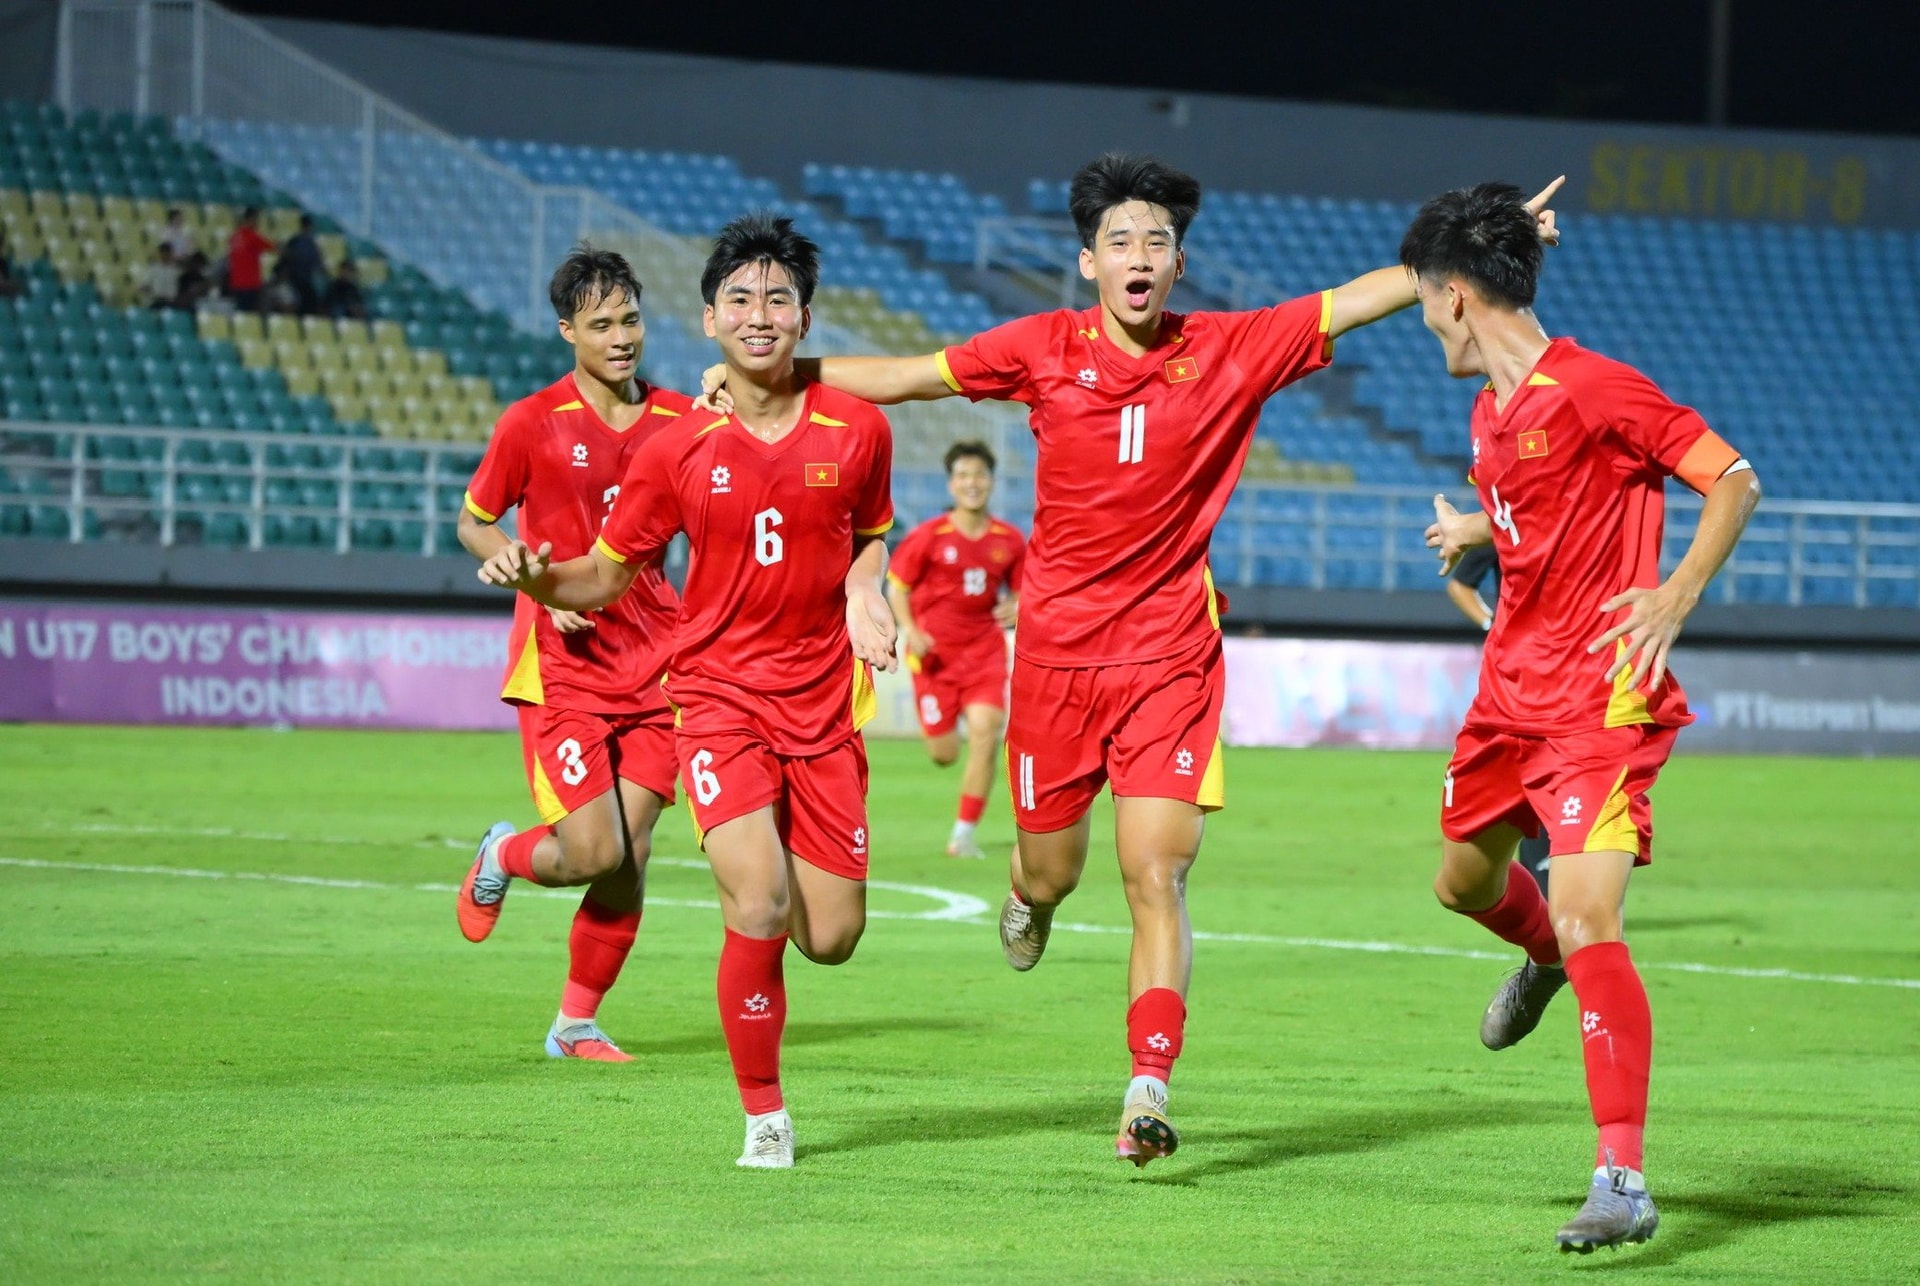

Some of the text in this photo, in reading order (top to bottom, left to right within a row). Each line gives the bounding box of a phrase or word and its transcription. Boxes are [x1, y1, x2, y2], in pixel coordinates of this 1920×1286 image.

[1118, 403, 1146, 464] 11
[754, 506, 784, 567] 6
[1491, 484, 1521, 547] 4
[26, 619, 98, 661] U17
[108, 621, 232, 664] BOYS'
[161, 674, 388, 719] INDONESIA
[556, 738, 588, 786] 3
[690, 749, 722, 806] 6
[1020, 752, 1036, 811] 11
